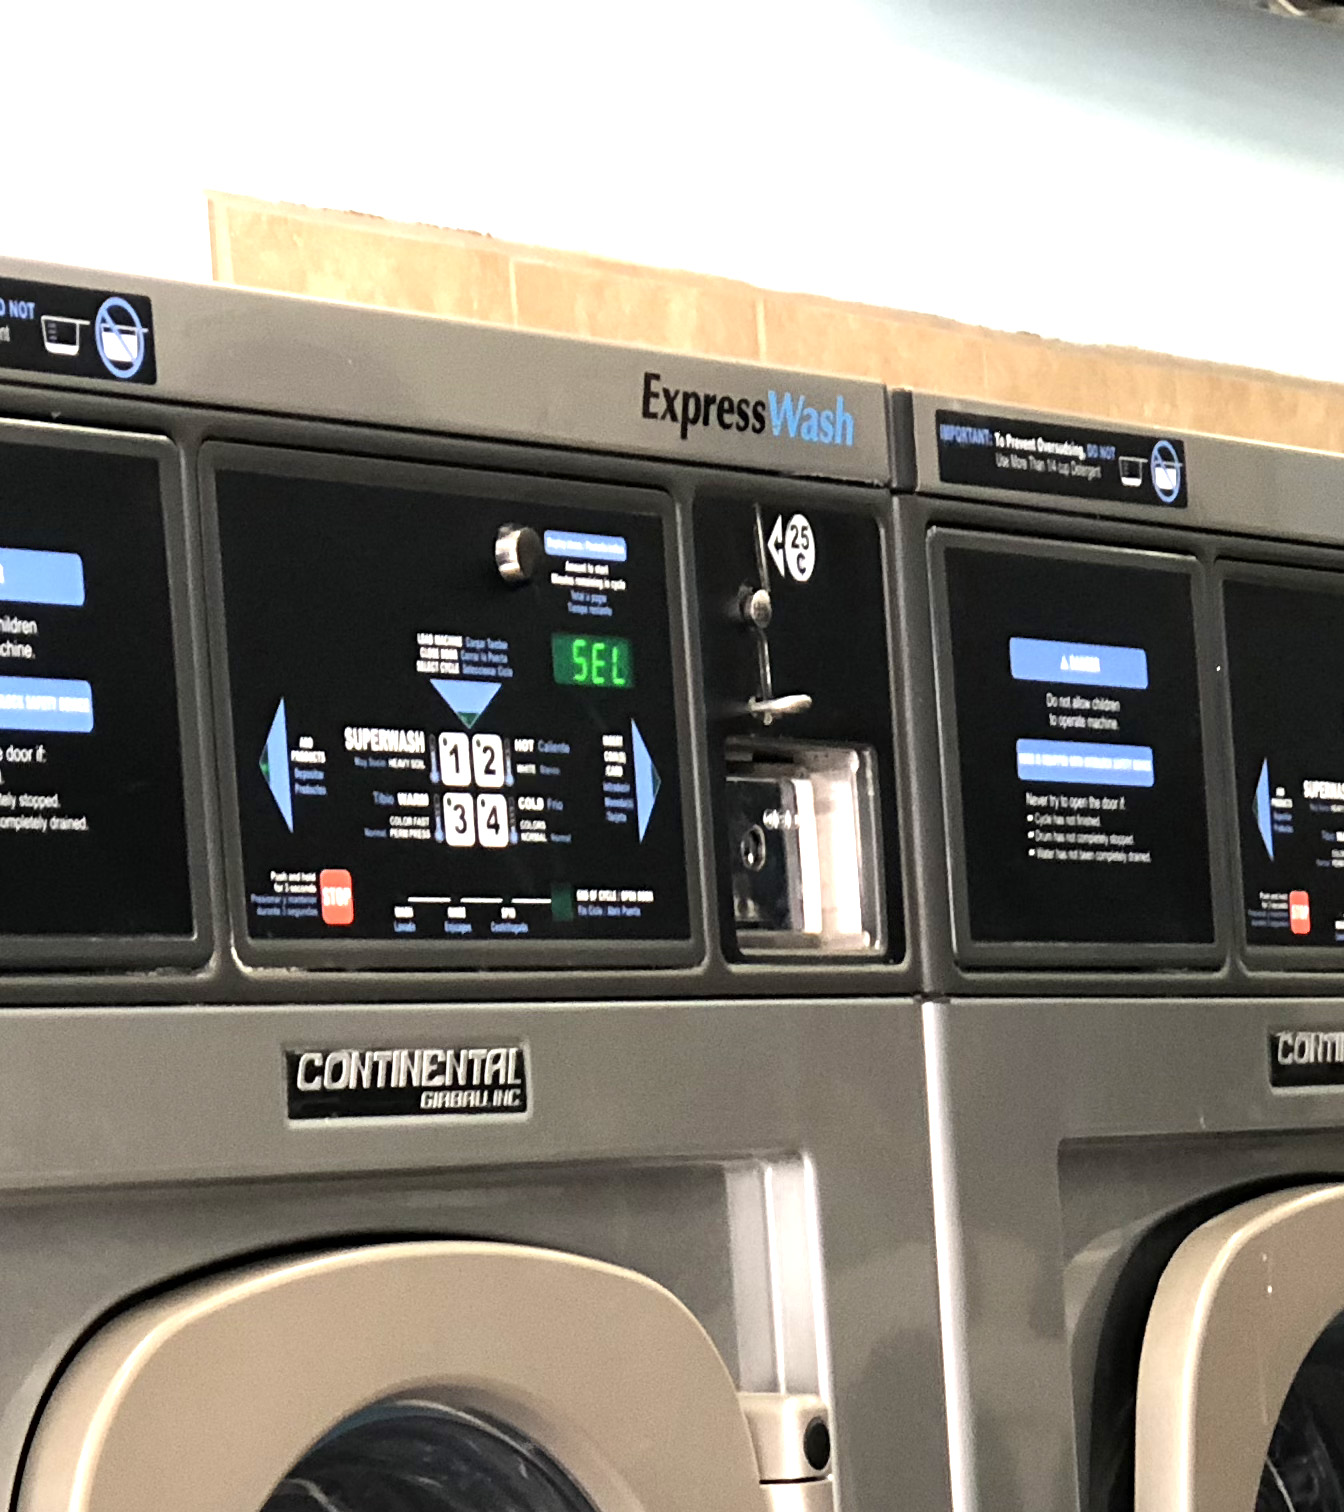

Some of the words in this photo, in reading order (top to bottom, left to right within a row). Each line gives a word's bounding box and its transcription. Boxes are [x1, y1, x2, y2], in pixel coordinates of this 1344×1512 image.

[8, 299, 35, 320] NOT
[641, 371, 855, 447] ExpressWash
[790, 524, 810, 550] 25
[796, 552, 807, 576] C
[5, 744, 33, 762] door
[344, 726, 426, 754] SUPERWASH
[514, 738, 535, 752] HOT
[449, 744, 460, 773] 1
[482, 746, 497, 776] 2
[518, 797, 544, 811] COLD
[454, 803, 467, 834] 3
[487, 805, 501, 835] 4
[322, 887, 352, 907] STOP
[296, 1047, 522, 1091] CONTINENTAL
